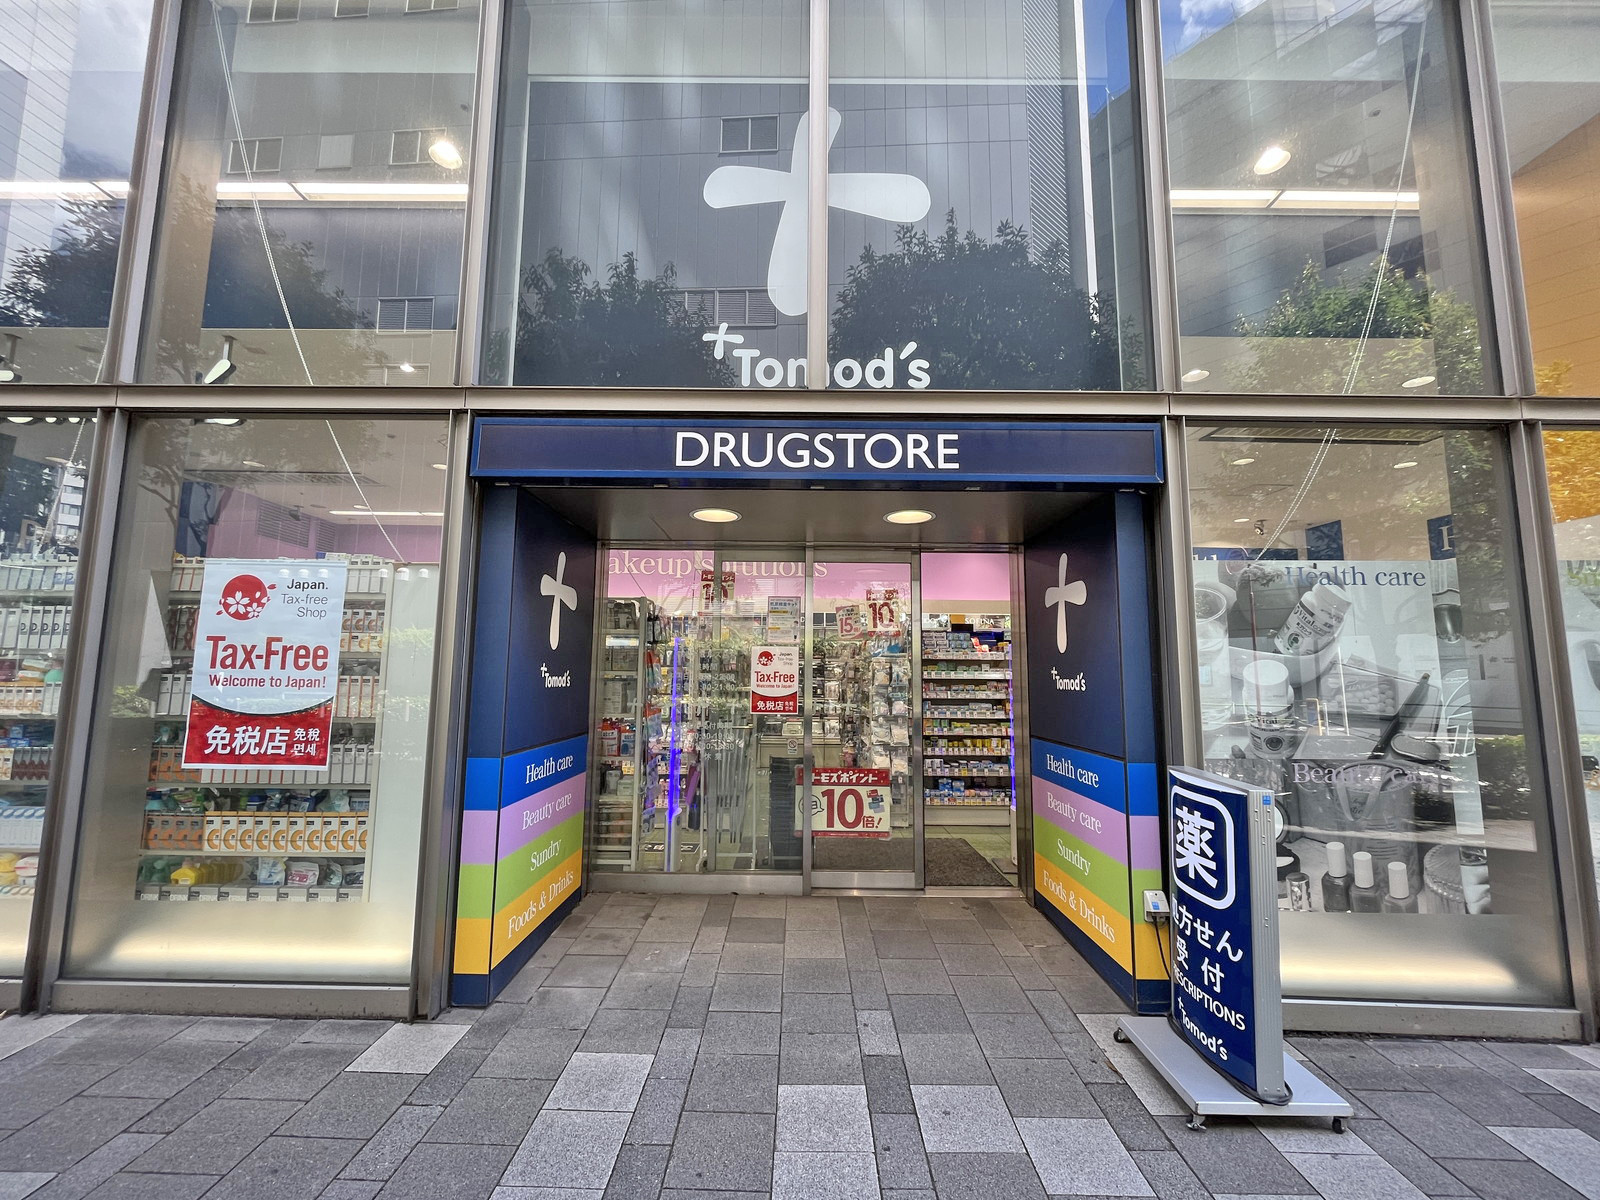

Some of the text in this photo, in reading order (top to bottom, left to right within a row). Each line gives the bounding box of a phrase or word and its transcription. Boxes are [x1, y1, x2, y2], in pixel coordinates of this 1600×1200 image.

[676, 432, 960, 470] DRUGSTORE
[287, 579, 329, 591] Japan.
[1285, 566, 1427, 587] Health care
[281, 594, 328, 605] Tax-free
[297, 607, 327, 620] Shop
[869, 602, 895, 628] 10
[206, 636, 329, 671] Tax-Free
[209, 675, 326, 692] Welcome to Japan!
[545, 670, 571, 688] Tomod's
[754, 671, 795, 683] Tax-Free
[1055, 672, 1086, 691] Tomod's
[757, 701, 784, 711] 免税店
[204, 725, 290, 755] 免税店
[293, 743, 317, 757] 면세
[525, 755, 573, 784] Health care
[812, 771, 878, 783] トモズポイント
[1046, 754, 1099, 788] Health care
[522, 794, 572, 830] Beauty care
[1047, 792, 1101, 834] Beauty care
[530, 839, 562, 871] Sundry
[1057, 839, 1091, 876] Sundry
[1176, 806, 1218, 889] 薬
[508, 870, 574, 939] Foods & Drinks
[1043, 870, 1116, 943] Foods & Drinks
[1181, 1009, 1228, 1061] Tomod's
